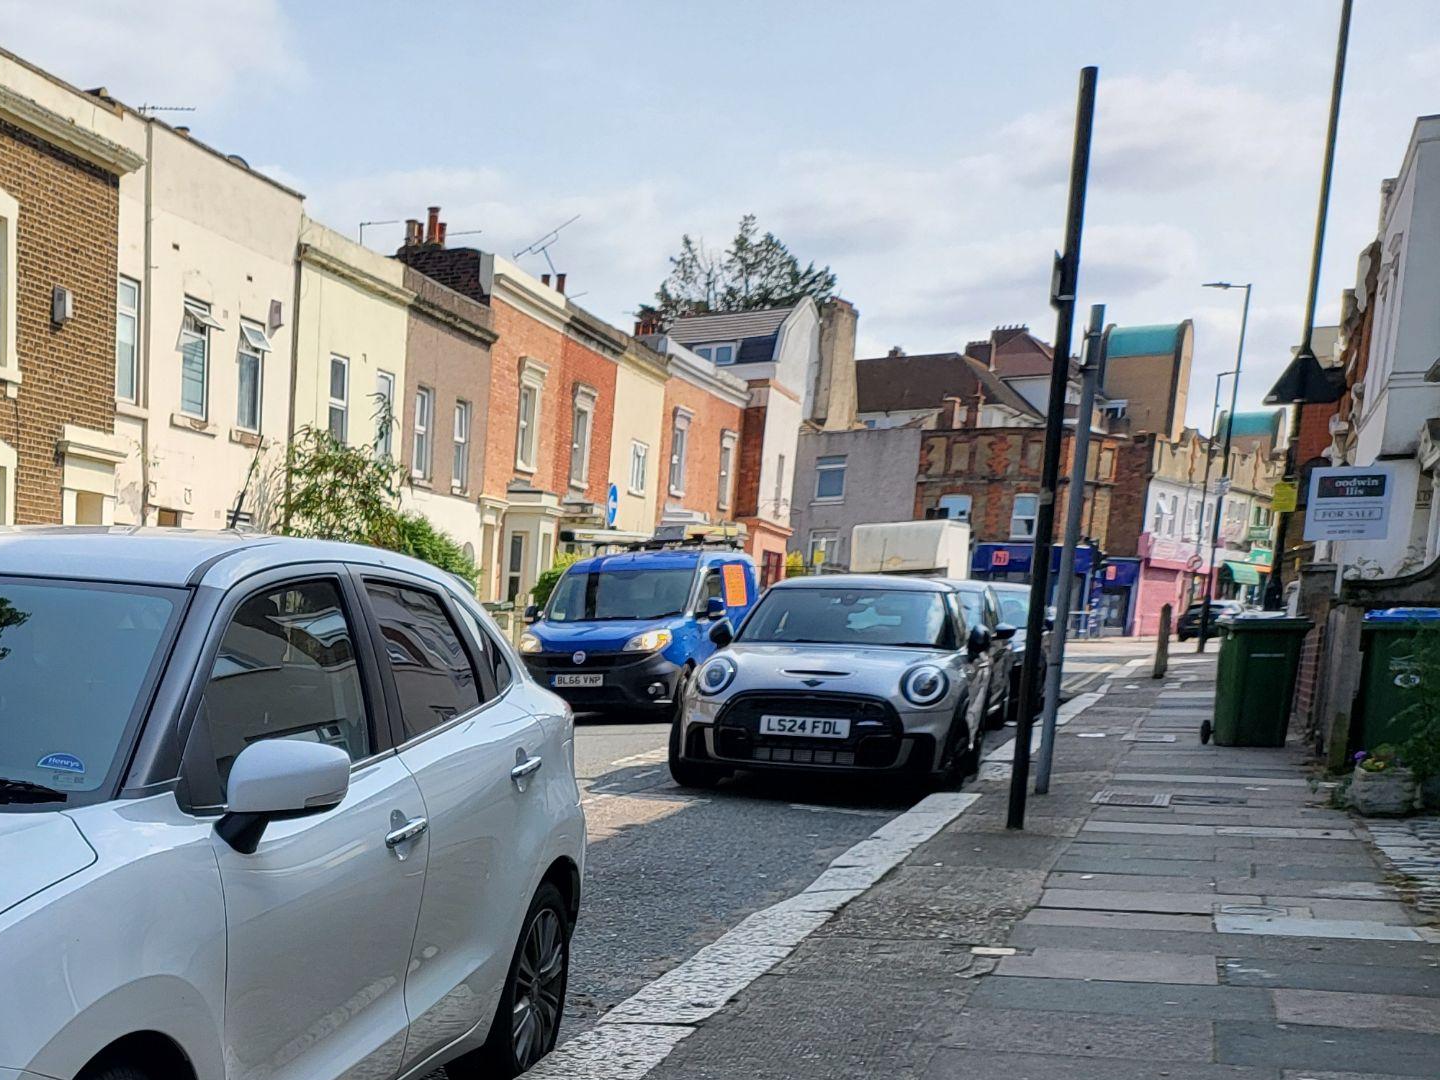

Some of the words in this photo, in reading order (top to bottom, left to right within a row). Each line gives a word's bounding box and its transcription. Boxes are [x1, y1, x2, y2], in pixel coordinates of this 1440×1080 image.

[1325, 477, 1379, 488] oodwin
[1338, 487, 1364, 496] llis
[1321, 510, 1344, 519] FOR
[1347, 509, 1374, 518] SALE
[583, 676, 601, 684] VNP
[767, 718, 807, 733] LS24
[811, 720, 842, 735] FDL
